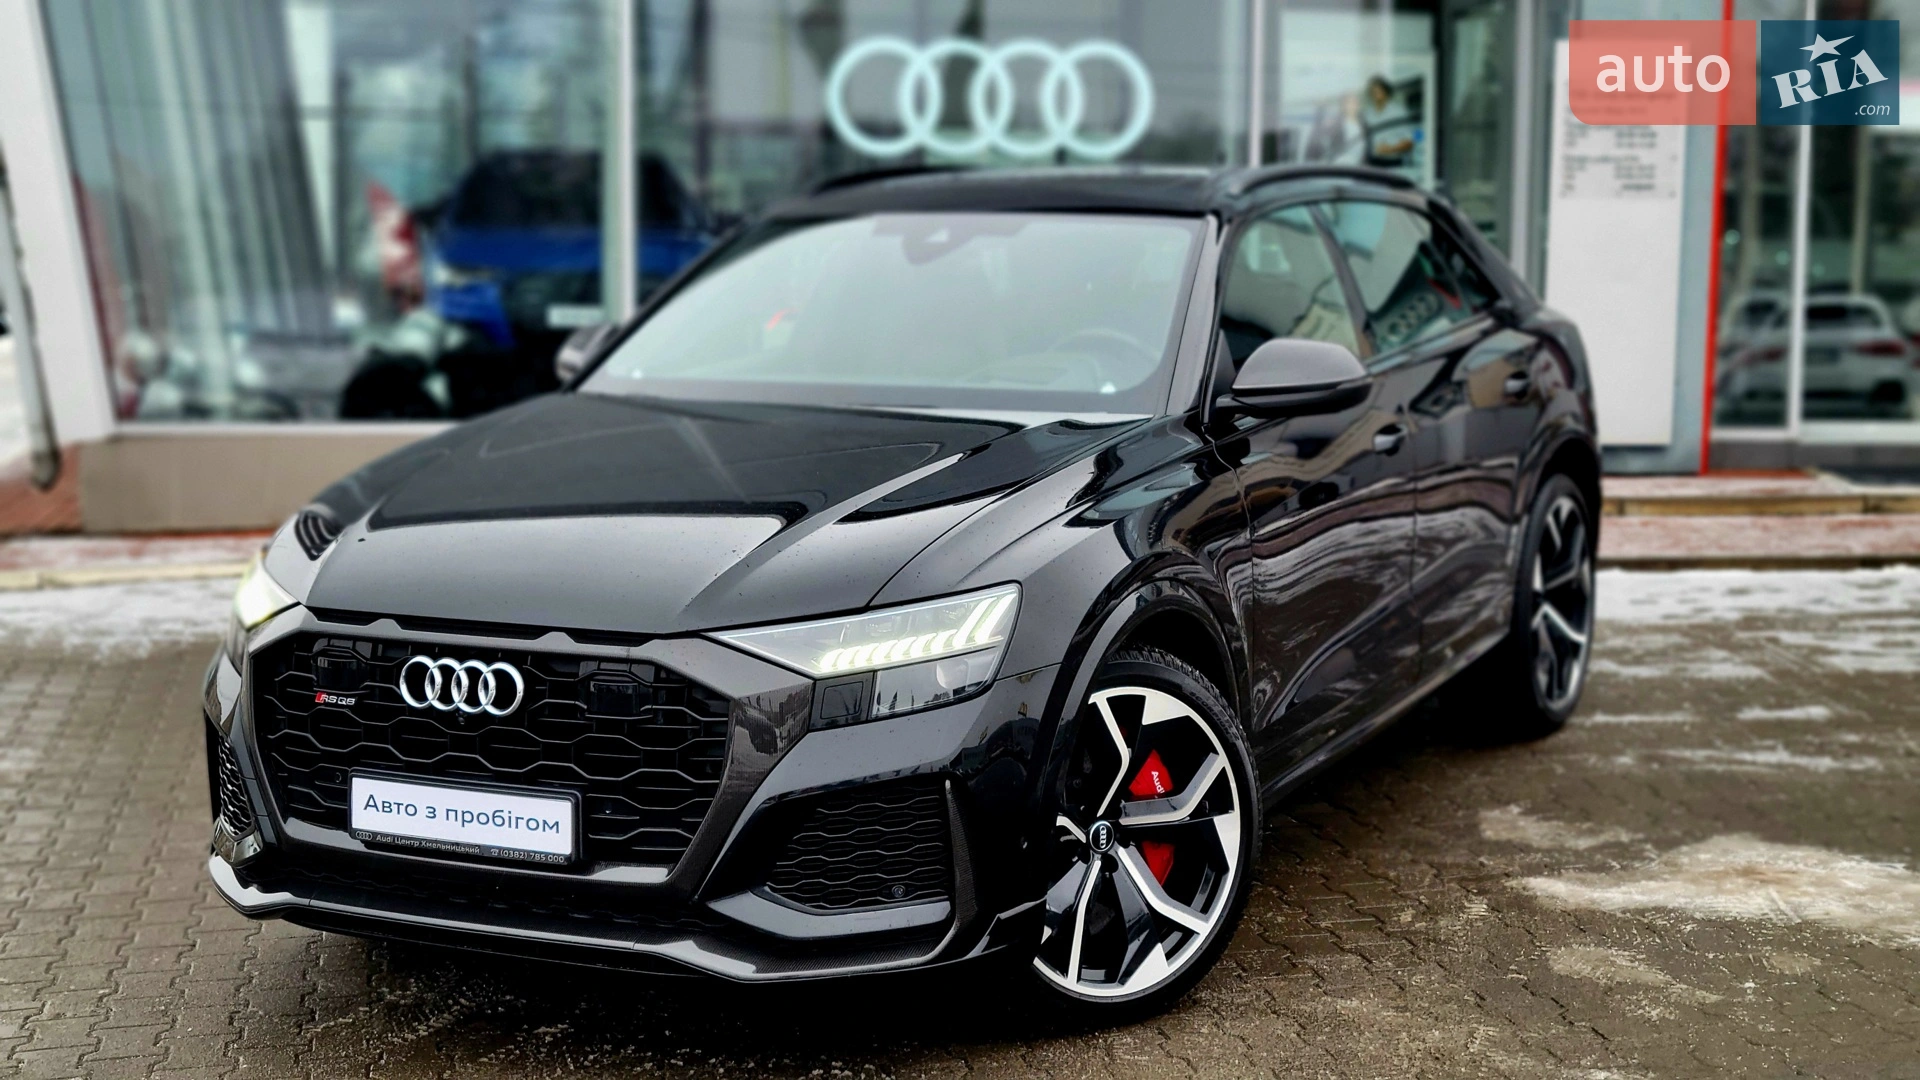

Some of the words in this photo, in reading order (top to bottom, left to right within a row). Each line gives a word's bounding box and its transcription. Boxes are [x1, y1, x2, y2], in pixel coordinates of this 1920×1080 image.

[1151, 771, 1165, 794] Audi
[363, 794, 418, 817] Авто
[425, 806, 437, 819] з
[445, 808, 560, 834] пробігом
[376, 834, 393, 843] Audi
[395, 836, 419, 847] Центр
[421, 840, 480, 854] Хмельницький
[500, 849, 528, 860] (0382)
[530, 852, 546, 861] 785
[547, 854, 565, 863] 000
